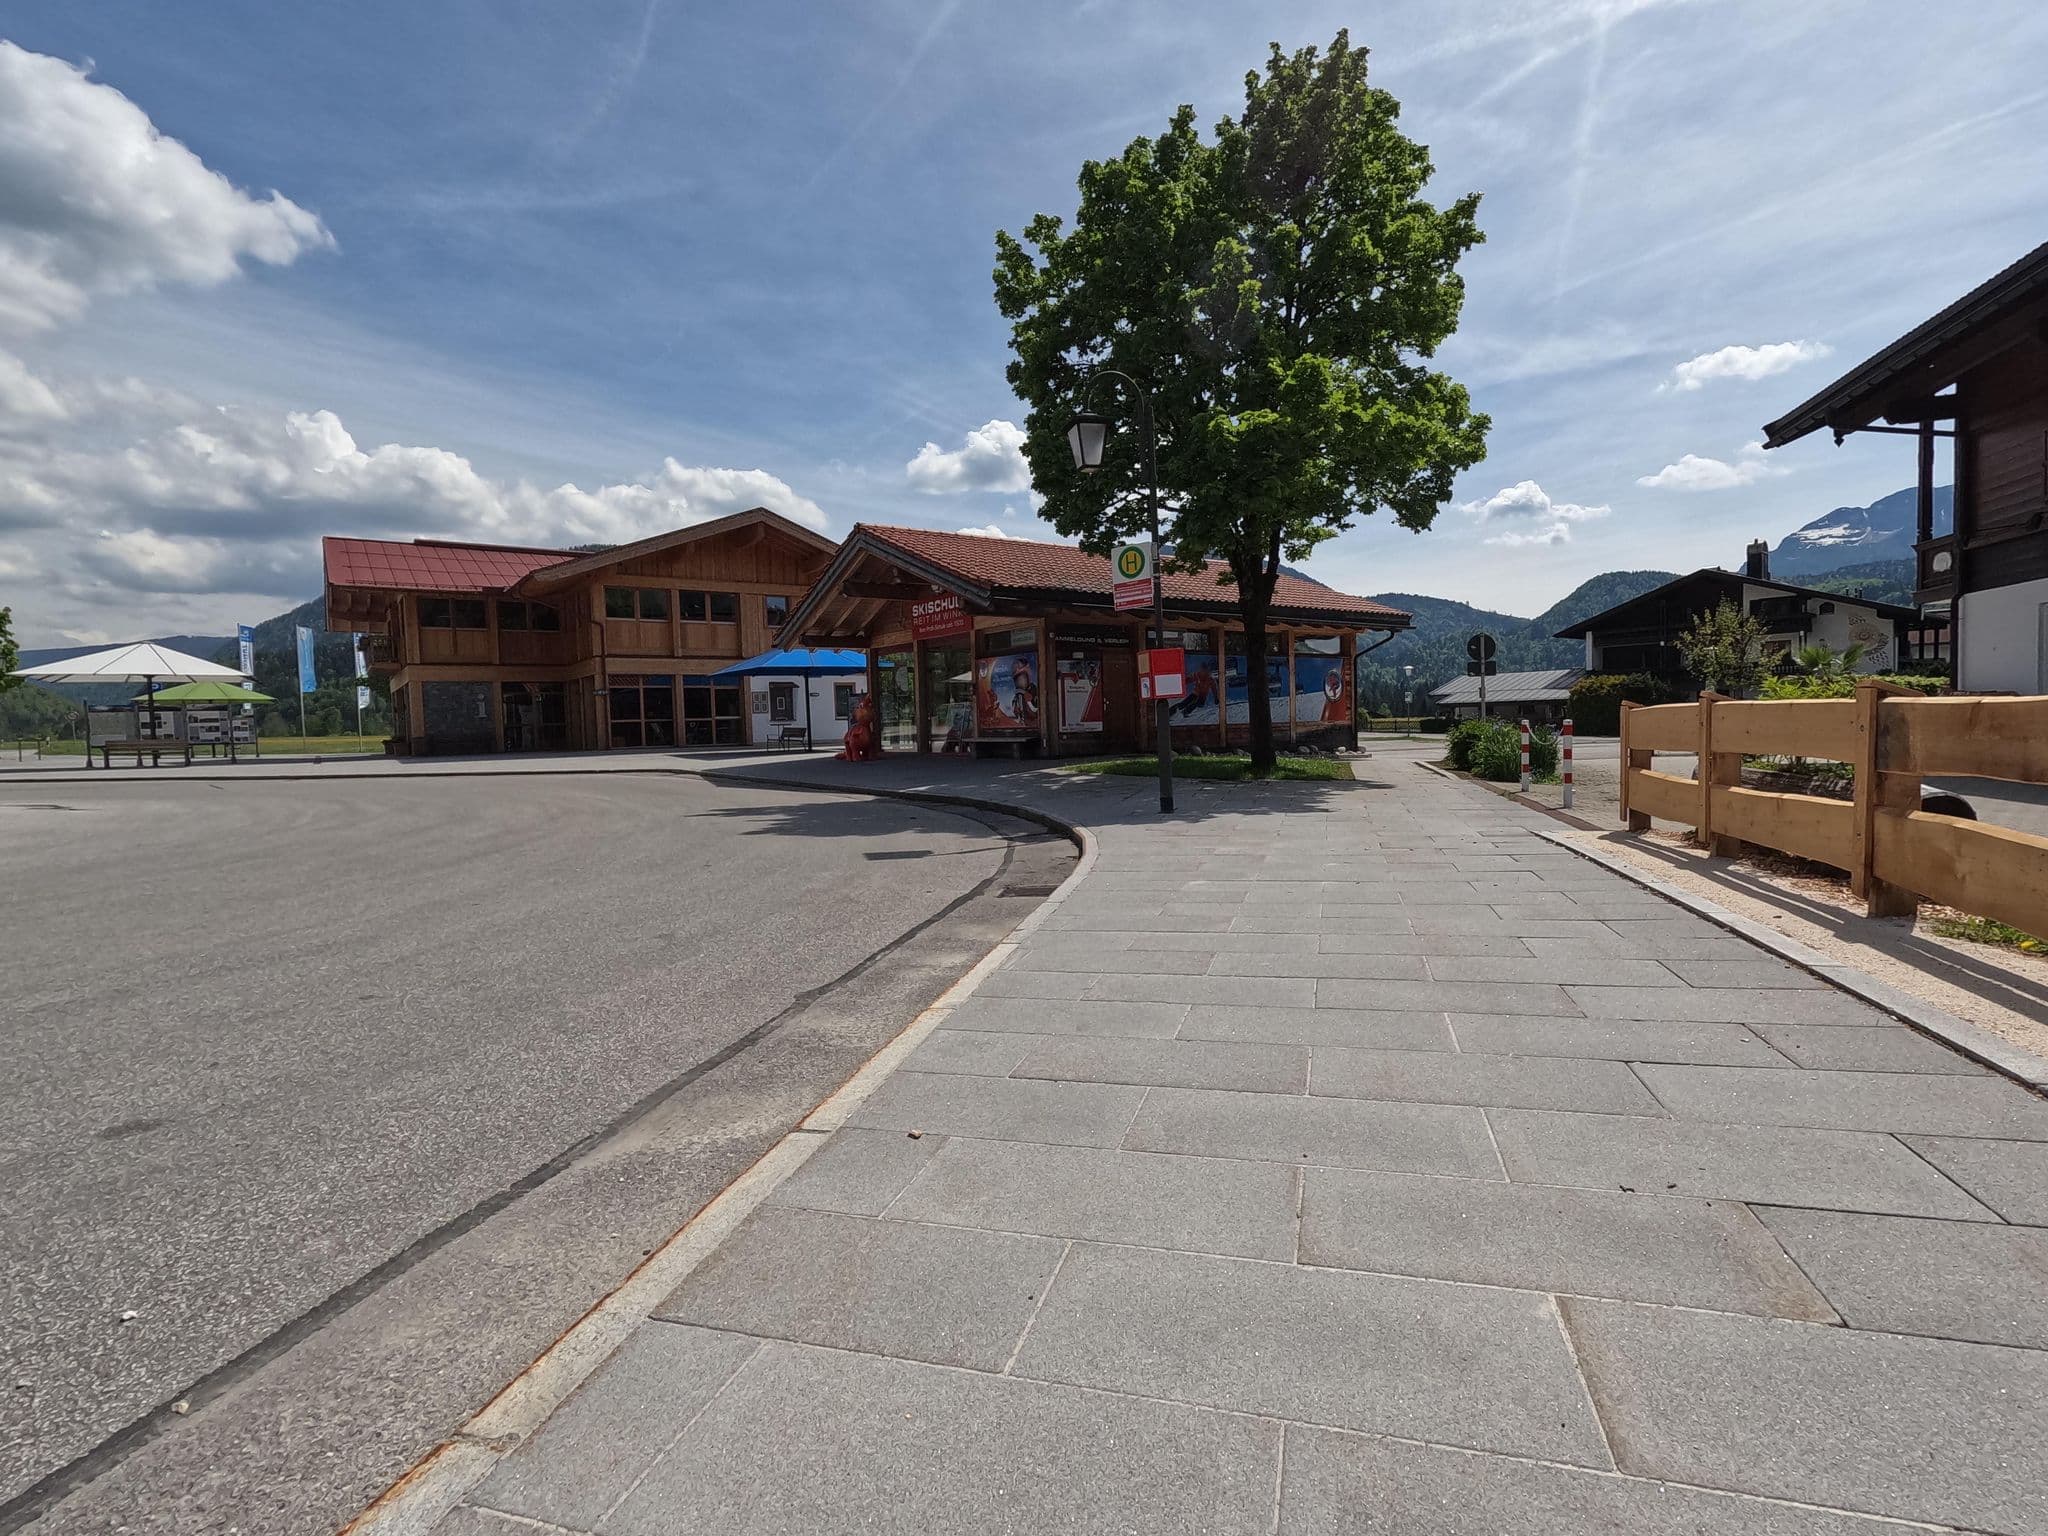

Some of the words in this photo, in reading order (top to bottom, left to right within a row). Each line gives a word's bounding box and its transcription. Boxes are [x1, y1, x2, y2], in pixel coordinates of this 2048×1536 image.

[1126, 553, 1137, 572] H
[912, 596, 959, 617] SKISCHUL
[913, 615, 930, 626] REIT
[931, 614, 941, 623] IM
[1055, 635, 1096, 643] ANMELDUNG
